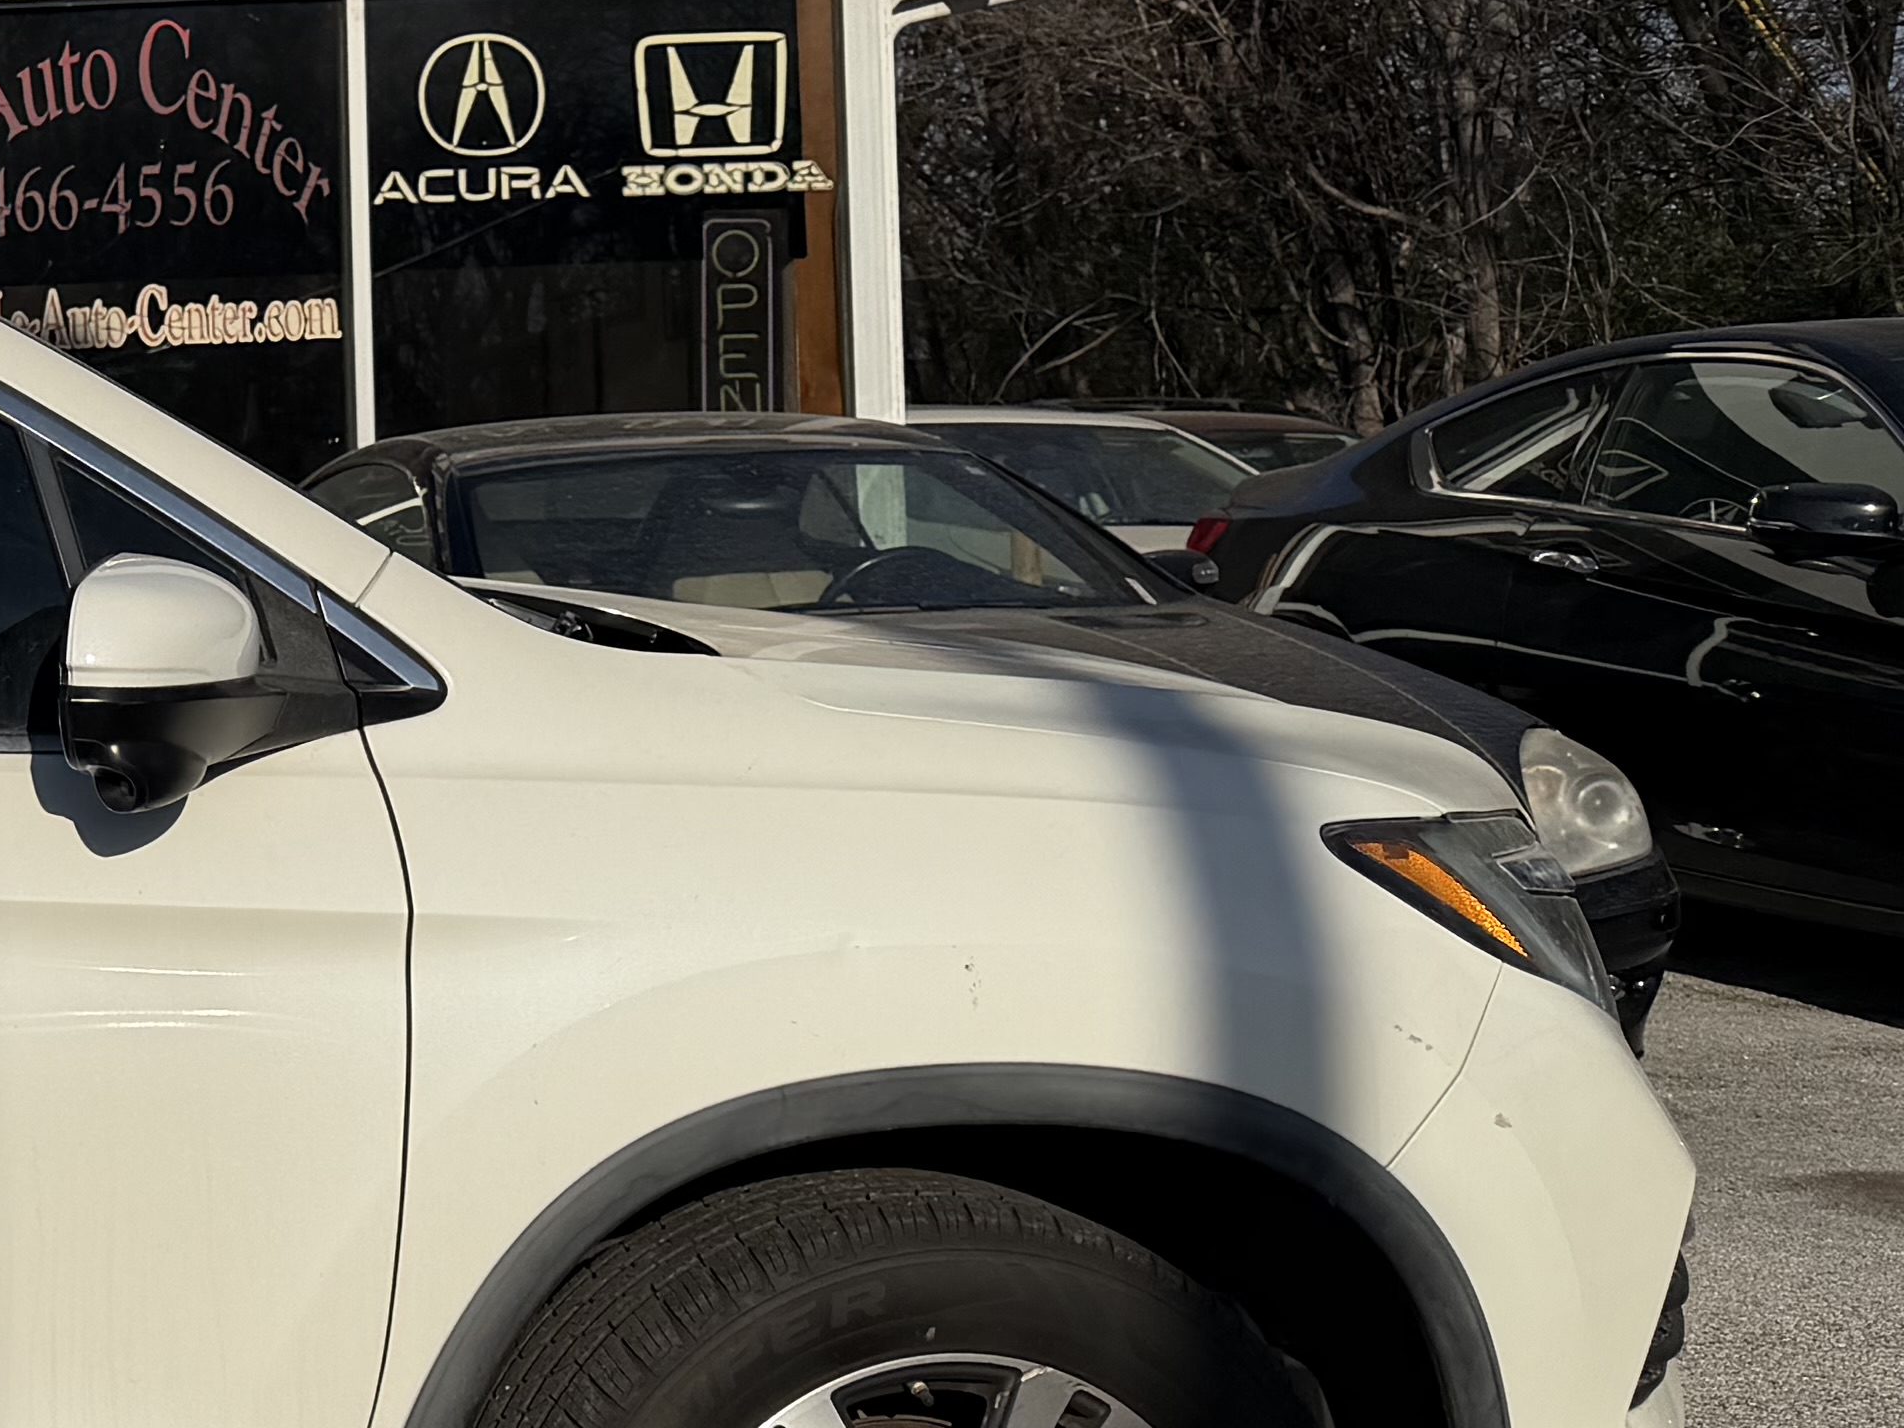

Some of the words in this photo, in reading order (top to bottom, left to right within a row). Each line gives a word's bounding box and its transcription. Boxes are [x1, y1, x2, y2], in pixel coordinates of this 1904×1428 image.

[138, 19, 332, 225] Center
[372, 165, 591, 206] ACURA
[621, 159, 835, 198] HONDA
[711, 228, 762, 412] OPEN
